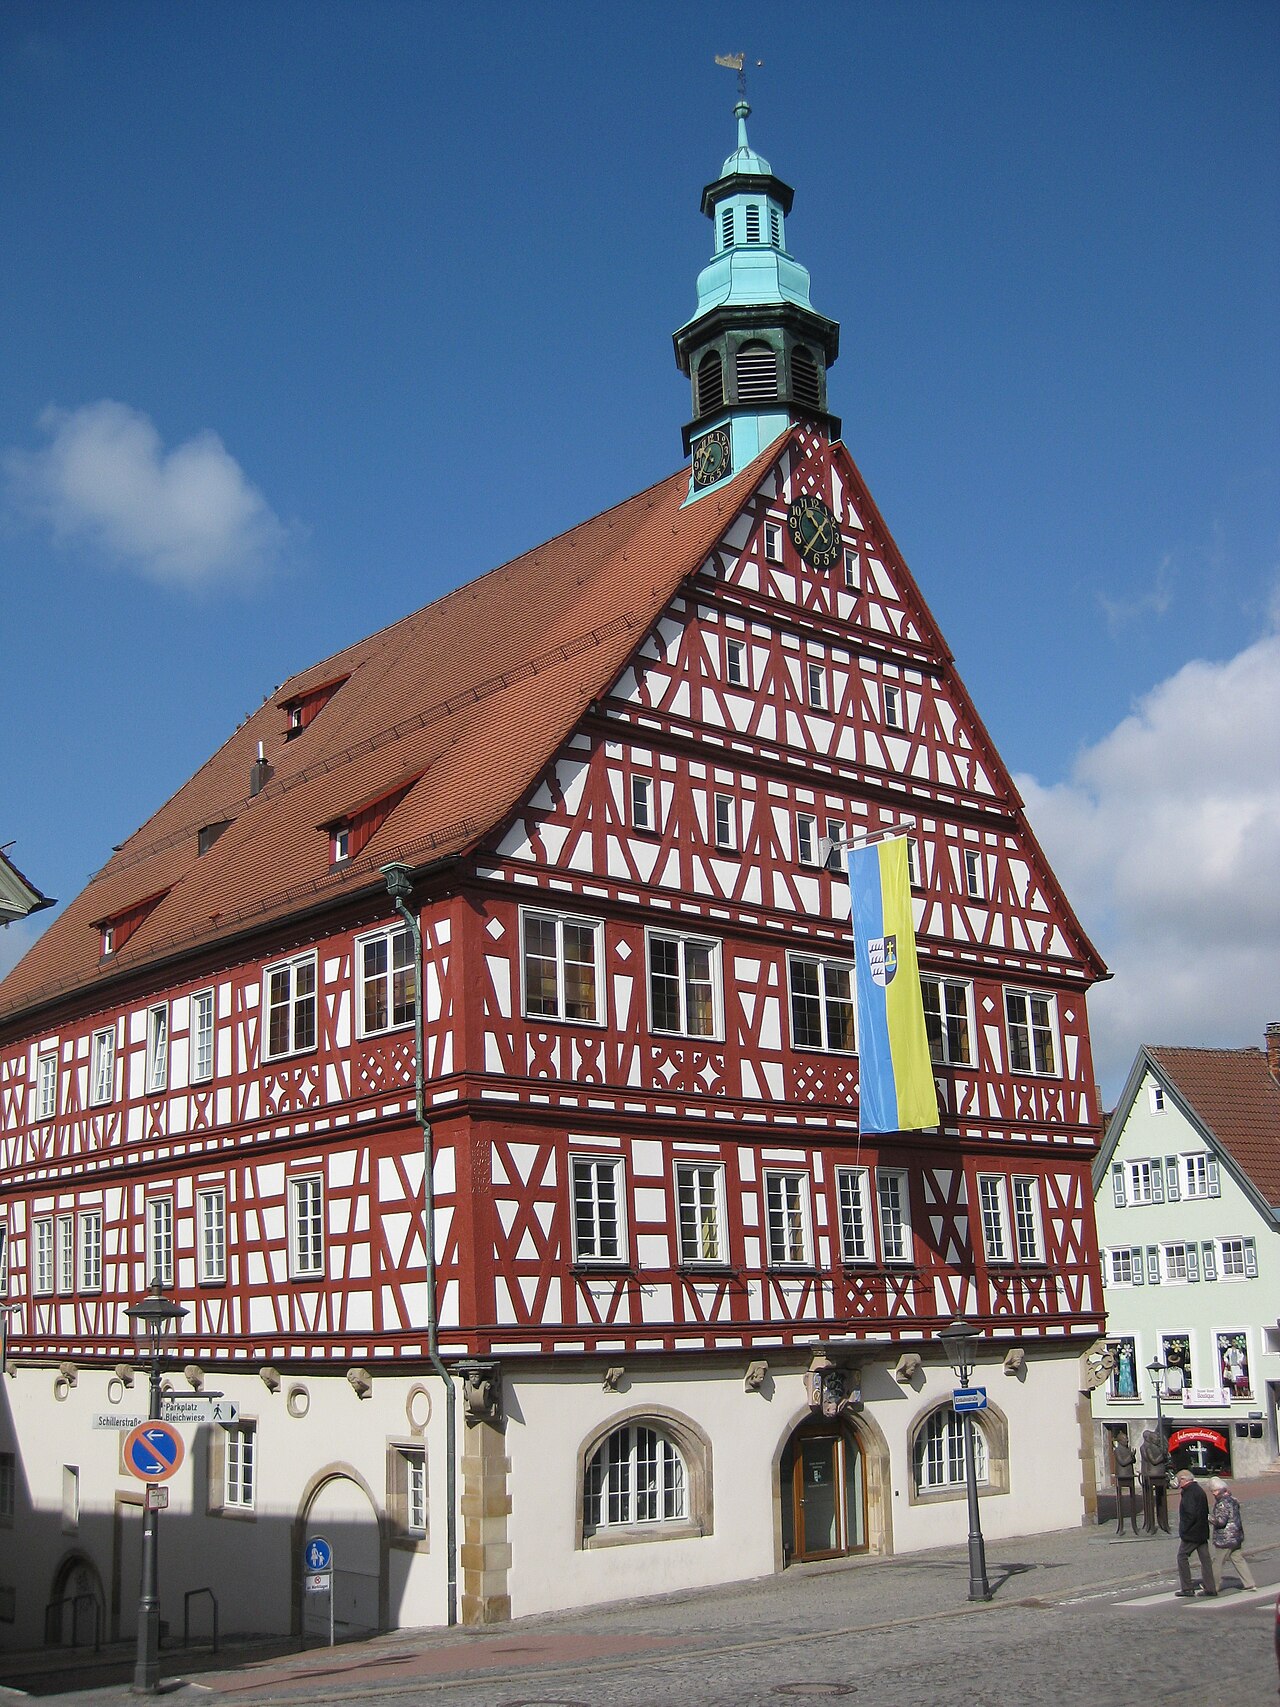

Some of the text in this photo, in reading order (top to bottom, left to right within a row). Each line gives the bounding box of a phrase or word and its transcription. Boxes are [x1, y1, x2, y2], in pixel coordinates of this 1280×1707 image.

[708, 433, 714, 444] 12
[724, 446, 728, 456] 3
[694, 460, 699, 470] 9
[717, 468, 722, 477] 5
[710, 474, 715, 483] 6
[800, 498, 807, 510] 11
[810, 498, 820, 510] 12
[792, 505, 801, 516] 10
[789, 516, 797, 528] 9
[831, 517, 837, 528] 2
[794, 531, 802, 545] 8
[834, 532, 839, 544] 3
[831, 547, 837, 558] 4
[813, 553, 820, 565] 6
[823, 553, 829, 565] 5
[166, 1403, 198, 1413] Parkplatz
[98, 1416, 142, 1427] Schillerstraße
[166, 1412, 205, 1422] Bleichwiese
